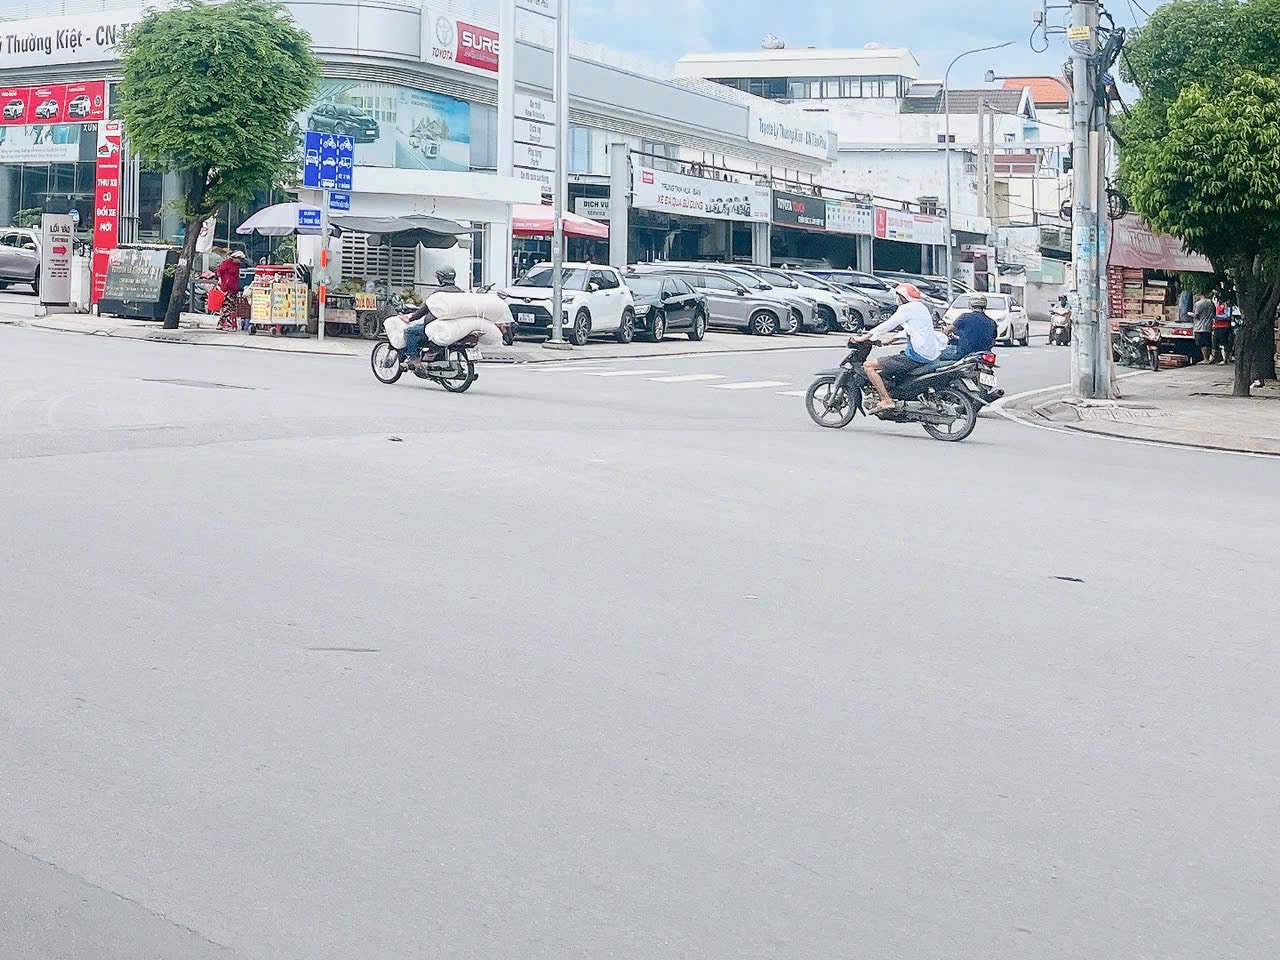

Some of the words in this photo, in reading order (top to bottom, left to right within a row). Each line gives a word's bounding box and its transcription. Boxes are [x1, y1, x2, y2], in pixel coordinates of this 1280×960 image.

[6, 32, 52, 55] Thường
[56, 28, 83, 53] Kiệt
[96, 24, 116, 46] CN
[432, 47, 453, 61] TOYOTA
